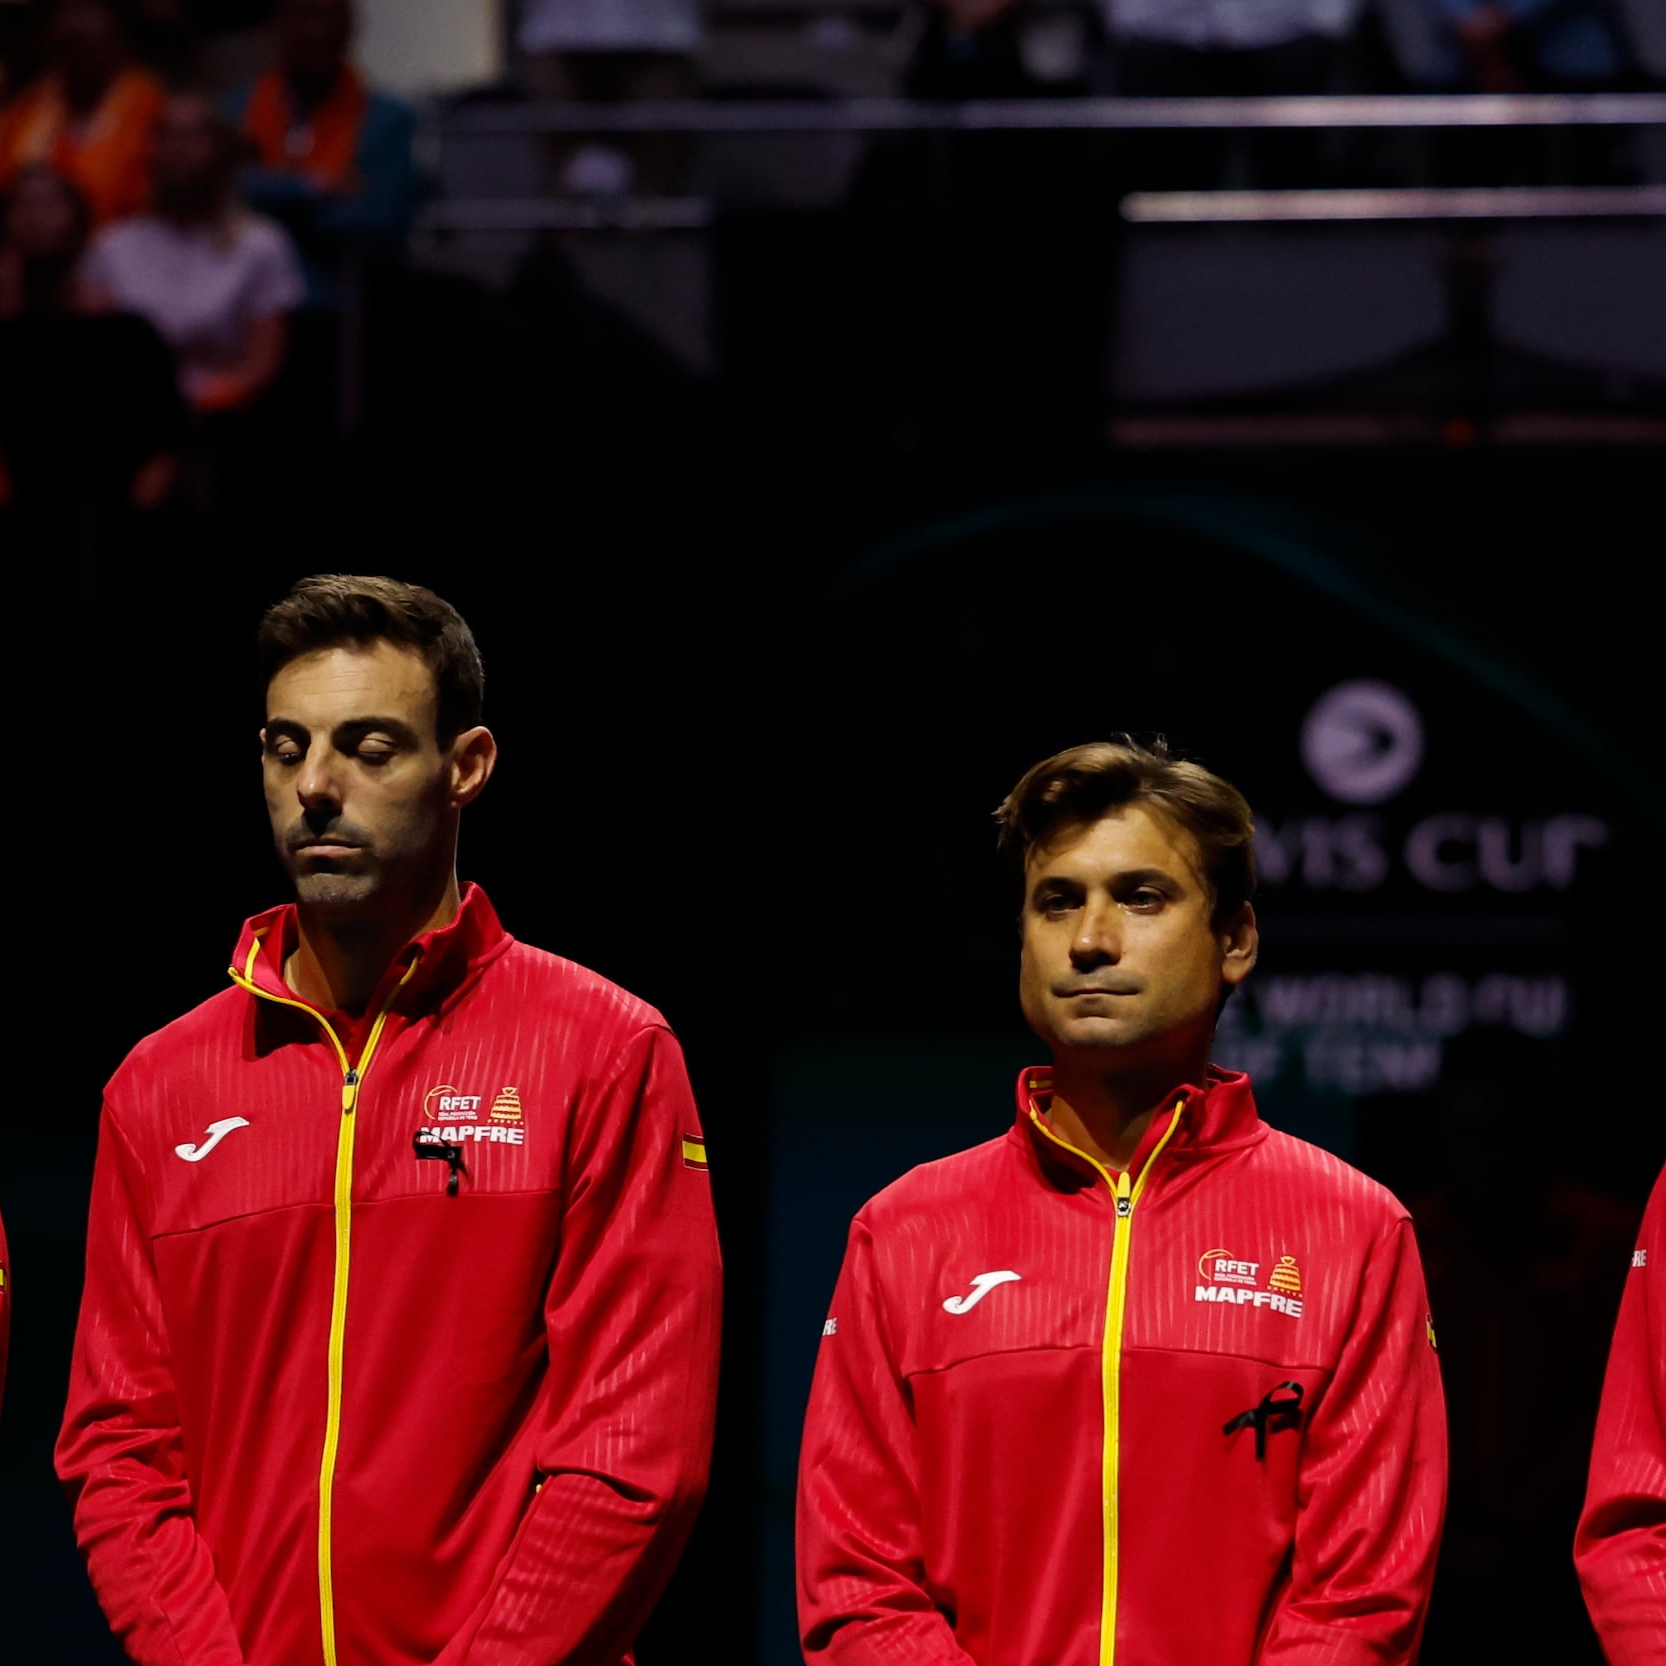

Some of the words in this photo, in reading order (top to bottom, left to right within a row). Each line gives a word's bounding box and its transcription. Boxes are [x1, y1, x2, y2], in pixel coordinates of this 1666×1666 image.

[1252, 810, 1391, 893] VIS
[439, 1095, 481, 1111] RFET
[420, 1126, 524, 1145] MAPFRE
[1215, 1259, 1259, 1276] RFET
[1195, 1285, 1303, 1318] MAPFRE
